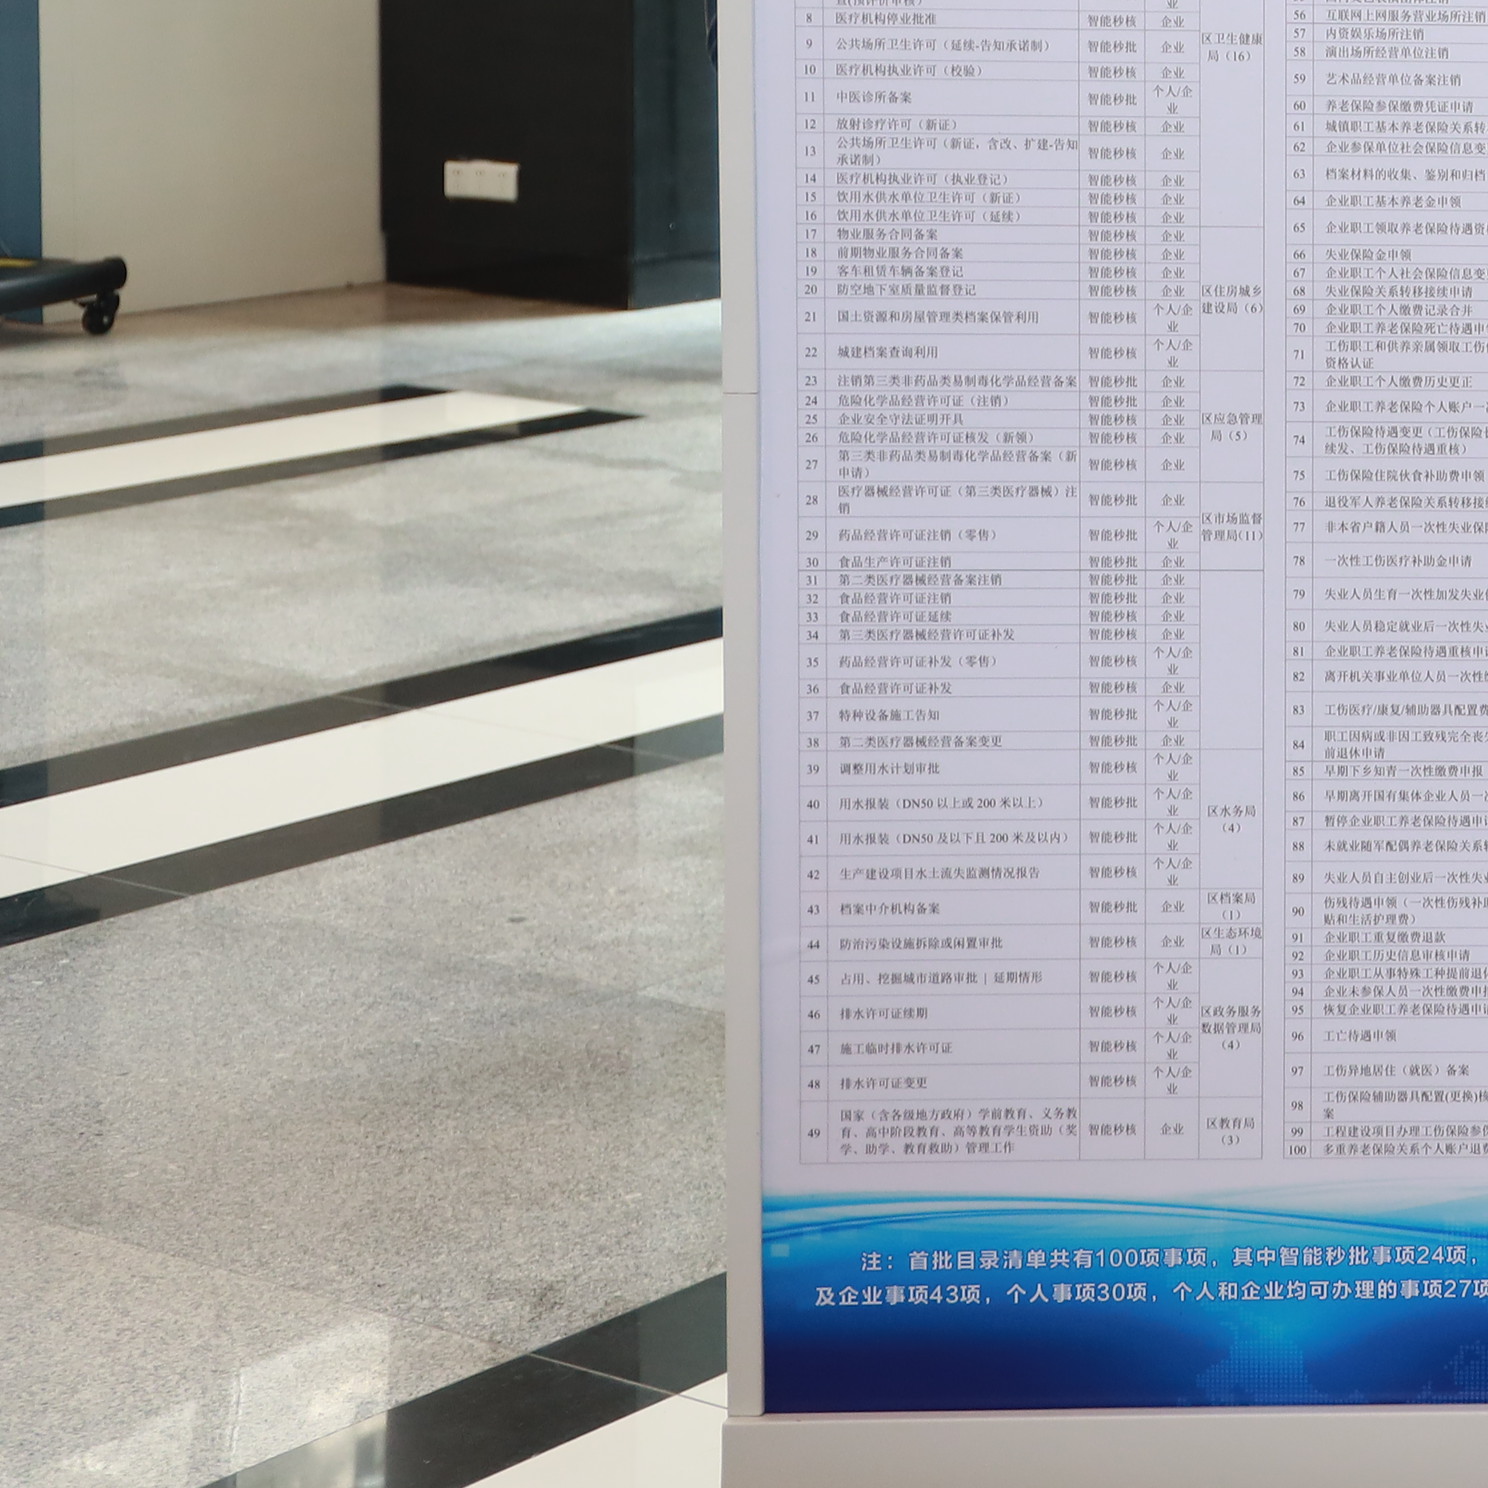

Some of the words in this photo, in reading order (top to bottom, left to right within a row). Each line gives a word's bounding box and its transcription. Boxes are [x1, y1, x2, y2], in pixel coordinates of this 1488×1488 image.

[835, 12, 936, 26] 医疗机构停业批准
[1326, 9, 1486, 23] 互联网上网服务营业场所注销
[1201, 32, 1263, 45] 区卫生健康
[1326, 27, 1424, 41] 内资娱乐场所注销
[836, 63, 983, 77] 医疗机构执业许可（校验）
[1326, 72, 1461, 86] 艺术品经营单位备案注销
[836, 91, 912, 105] 中医诊所备案
[836, 118, 959, 131] 放射诊疗许可（新证）
[1326, 194, 1461, 208] 企业职工基本养老金申领
[837, 228, 938, 242] 物业服务合同备案
[837, 246, 963, 260] 前期物业服务合同备案
[1326, 248, 1412, 262] 失业保险金申领
[837, 265, 964, 278] 客车租赁车辆备案登记
[837, 283, 976, 297] 防空地下室质量监督登记
[1201, 284, 1263, 298] 区住房城乡
[1326, 285, 1473, 298] 失业保险关系转移接续申请
[837, 310, 1039, 324] 国土资源和房屋管理类档案保管利用
[837, 346, 938, 359] 城建档案查询利用
[839, 412, 964, 426] 企业安全守法证明开具
[1201, 412, 1263, 426] 区应急管理
[1325, 469, 1485, 483] 工伤保险住院伙食补助费申领
[839, 555, 951, 569] 食品生产许可证注销
[1325, 554, 1472, 568] 一次性工伤医疗补助金申请
[839, 573, 1002, 587] 第二类医疗器械经营备案注销
[839, 628, 1015, 642] 第三类医疗器械经营许可证补发
[839, 709, 940, 723] 特种设备施工告知
[840, 762, 940, 776] 调整用水计划审批
[1325, 764, 1483, 778] 早期下乡知青一次性缴费申报
[1207, 804, 1256, 818] 区水务局
[840, 867, 1040, 881] 生产建设项目水土流失监测情况报告
[840, 902, 940, 916] 档案中介机构备案
[840, 937, 1003, 951] 防治污染设施拆除或闲置审批
[1324, 930, 1446, 944] 企业职工重复缴费退款
[840, 1007, 927, 1021] 排水许可证续期
[1323, 1029, 1397, 1043] 工亡待遇申领
[840, 1042, 953, 1055] 施工临时排水许可证
[1288, 1143, 1307, 1156] 100
